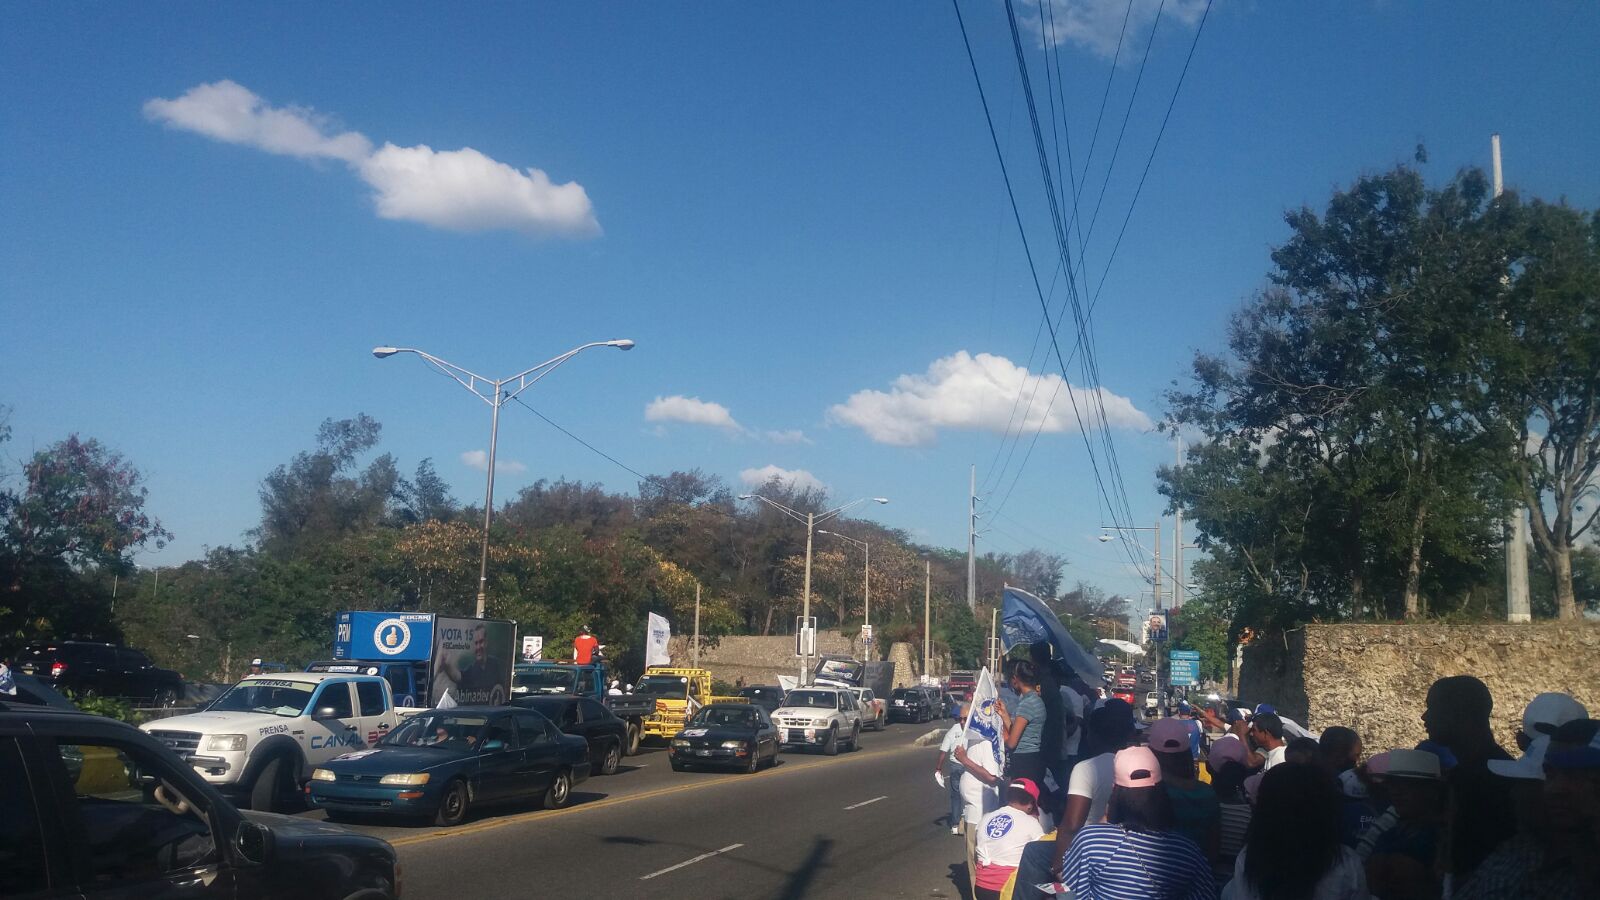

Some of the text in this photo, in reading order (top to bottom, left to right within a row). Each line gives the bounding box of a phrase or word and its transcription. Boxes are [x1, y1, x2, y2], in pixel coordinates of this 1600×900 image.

[337, 623, 351, 642] PRM
[441, 628, 474, 641] VOTA 15
[254, 680, 293, 688] PRENSA
[259, 724, 289, 736] PRENSA
[311, 731, 363, 749] CANAL
[989, 827, 1004, 839] 15
